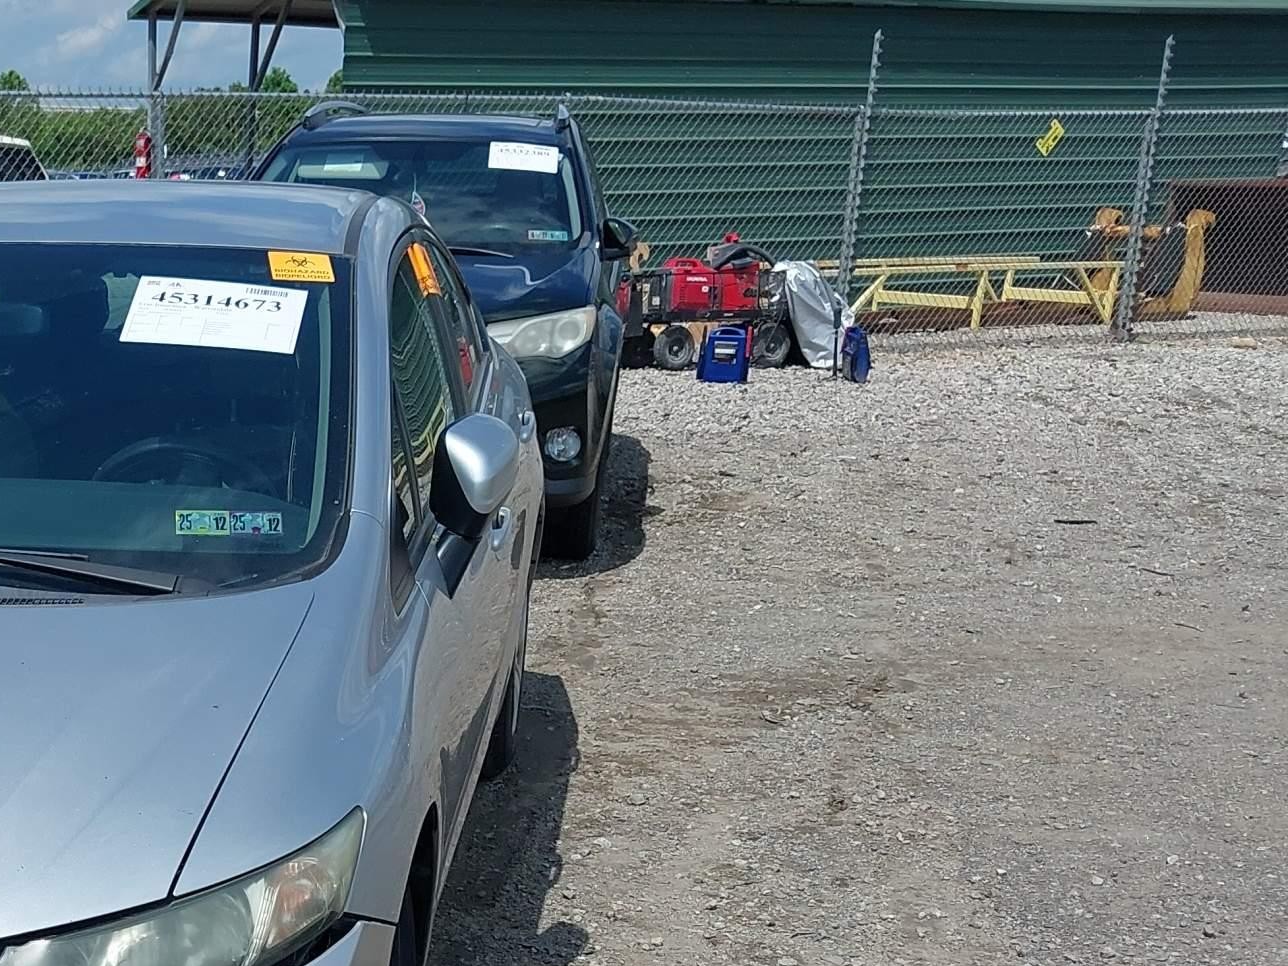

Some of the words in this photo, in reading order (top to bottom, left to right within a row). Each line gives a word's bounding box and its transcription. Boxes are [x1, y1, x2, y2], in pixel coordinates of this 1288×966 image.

[151, 290, 283, 313] 45314673
[179, 513, 192, 531] 25
[213, 516, 227, 531] 12
[231, 514, 246, 531] 25
[266, 517, 281, 532] 12
